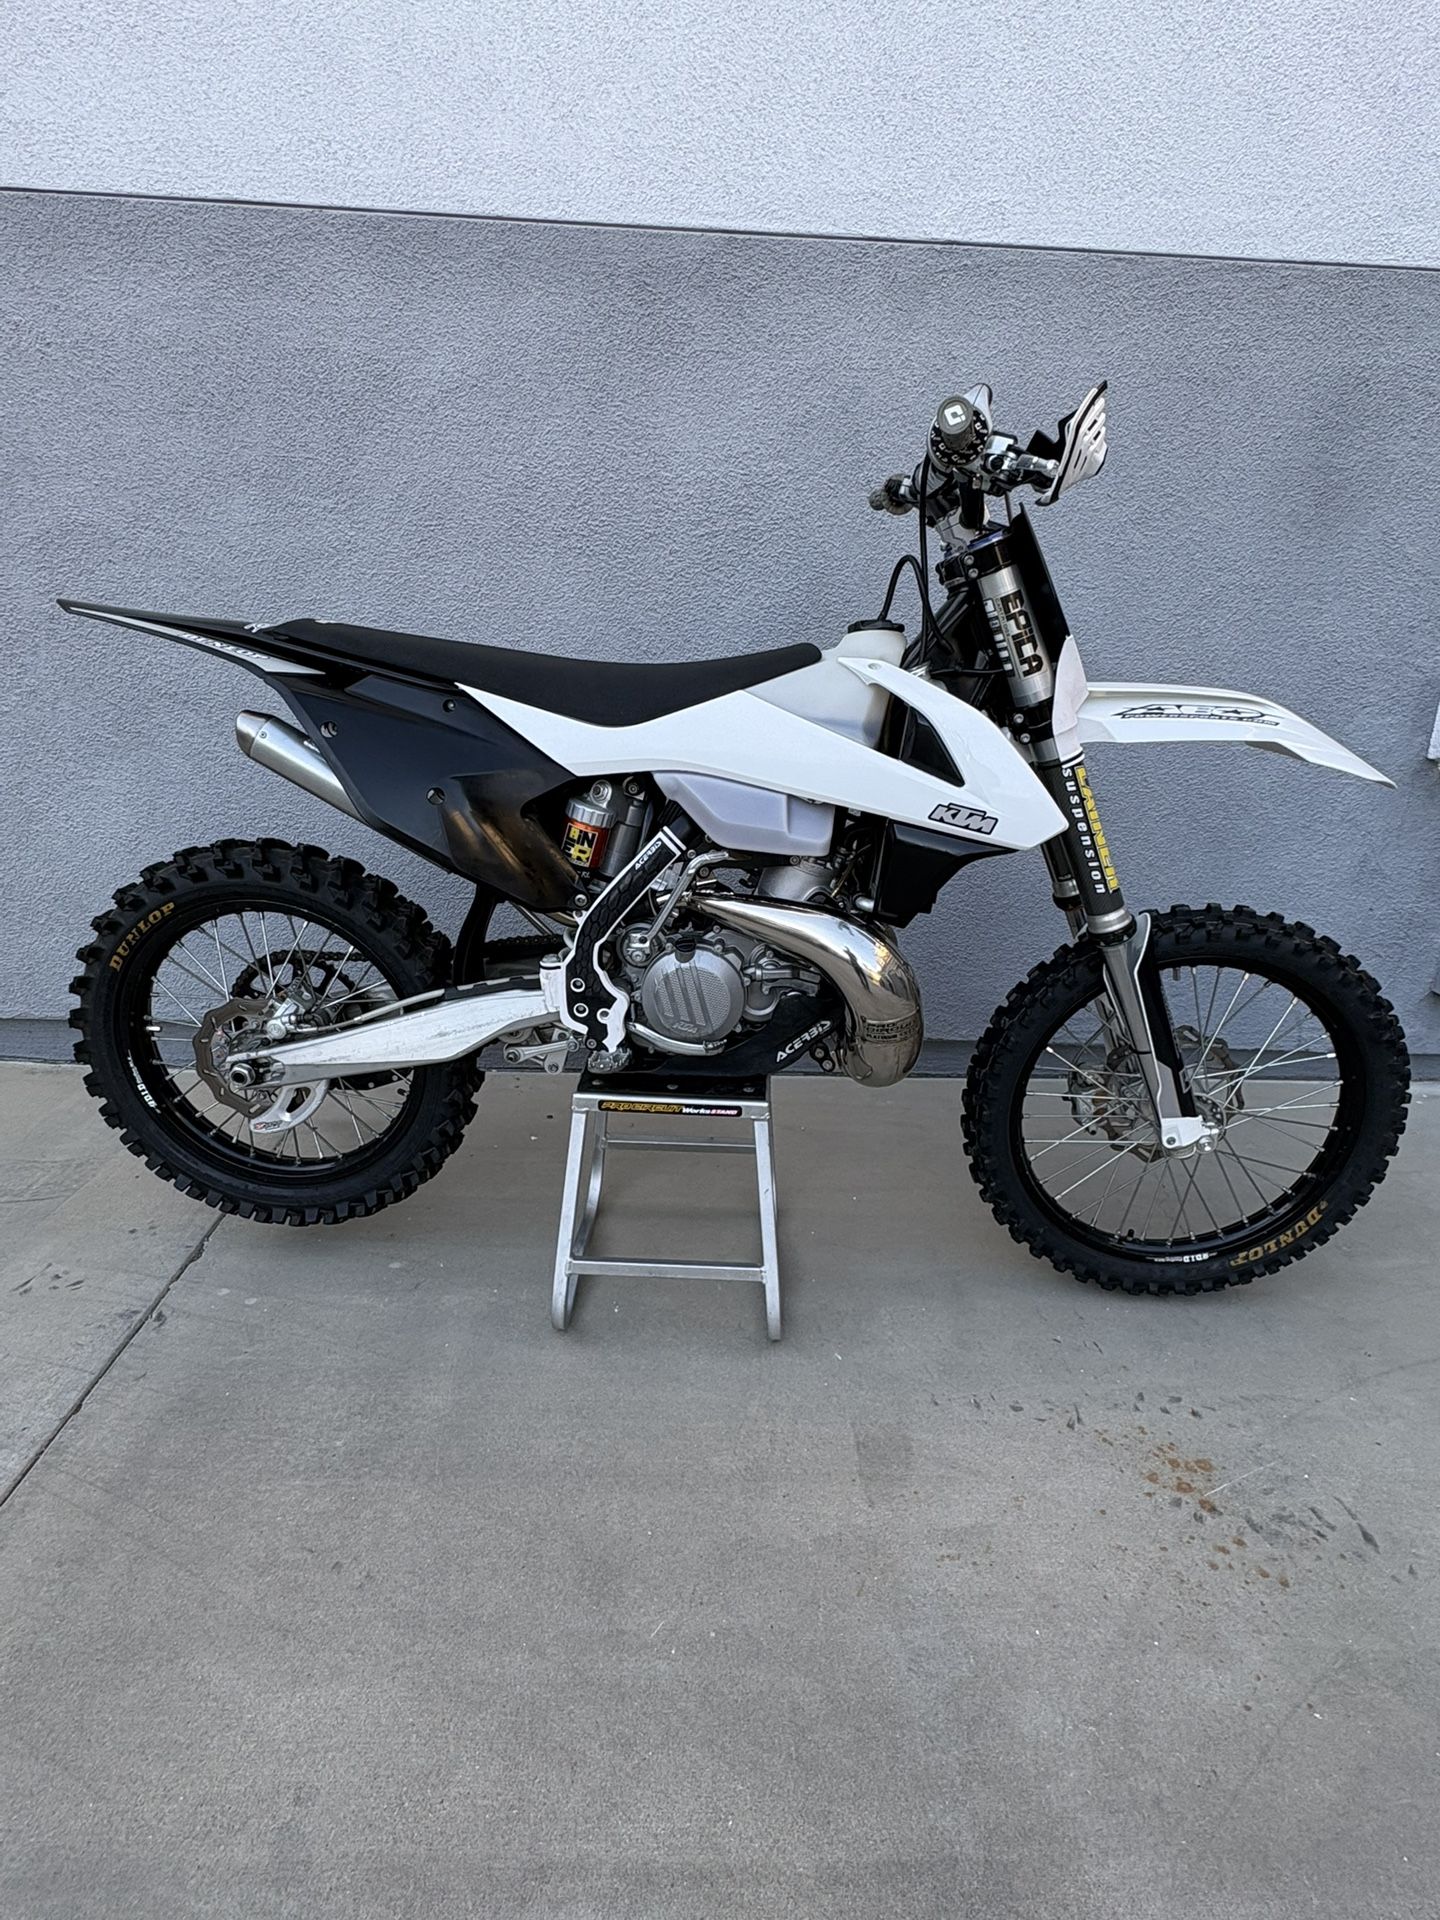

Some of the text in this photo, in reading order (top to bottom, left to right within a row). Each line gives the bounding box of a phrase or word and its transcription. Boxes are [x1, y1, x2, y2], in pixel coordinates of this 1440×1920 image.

[928, 802, 999, 835] KTM
[1062, 767, 1106, 894] suspension
[109, 902, 175, 972] DUNLOP
[1230, 1207, 1323, 1266] DUNLOP
